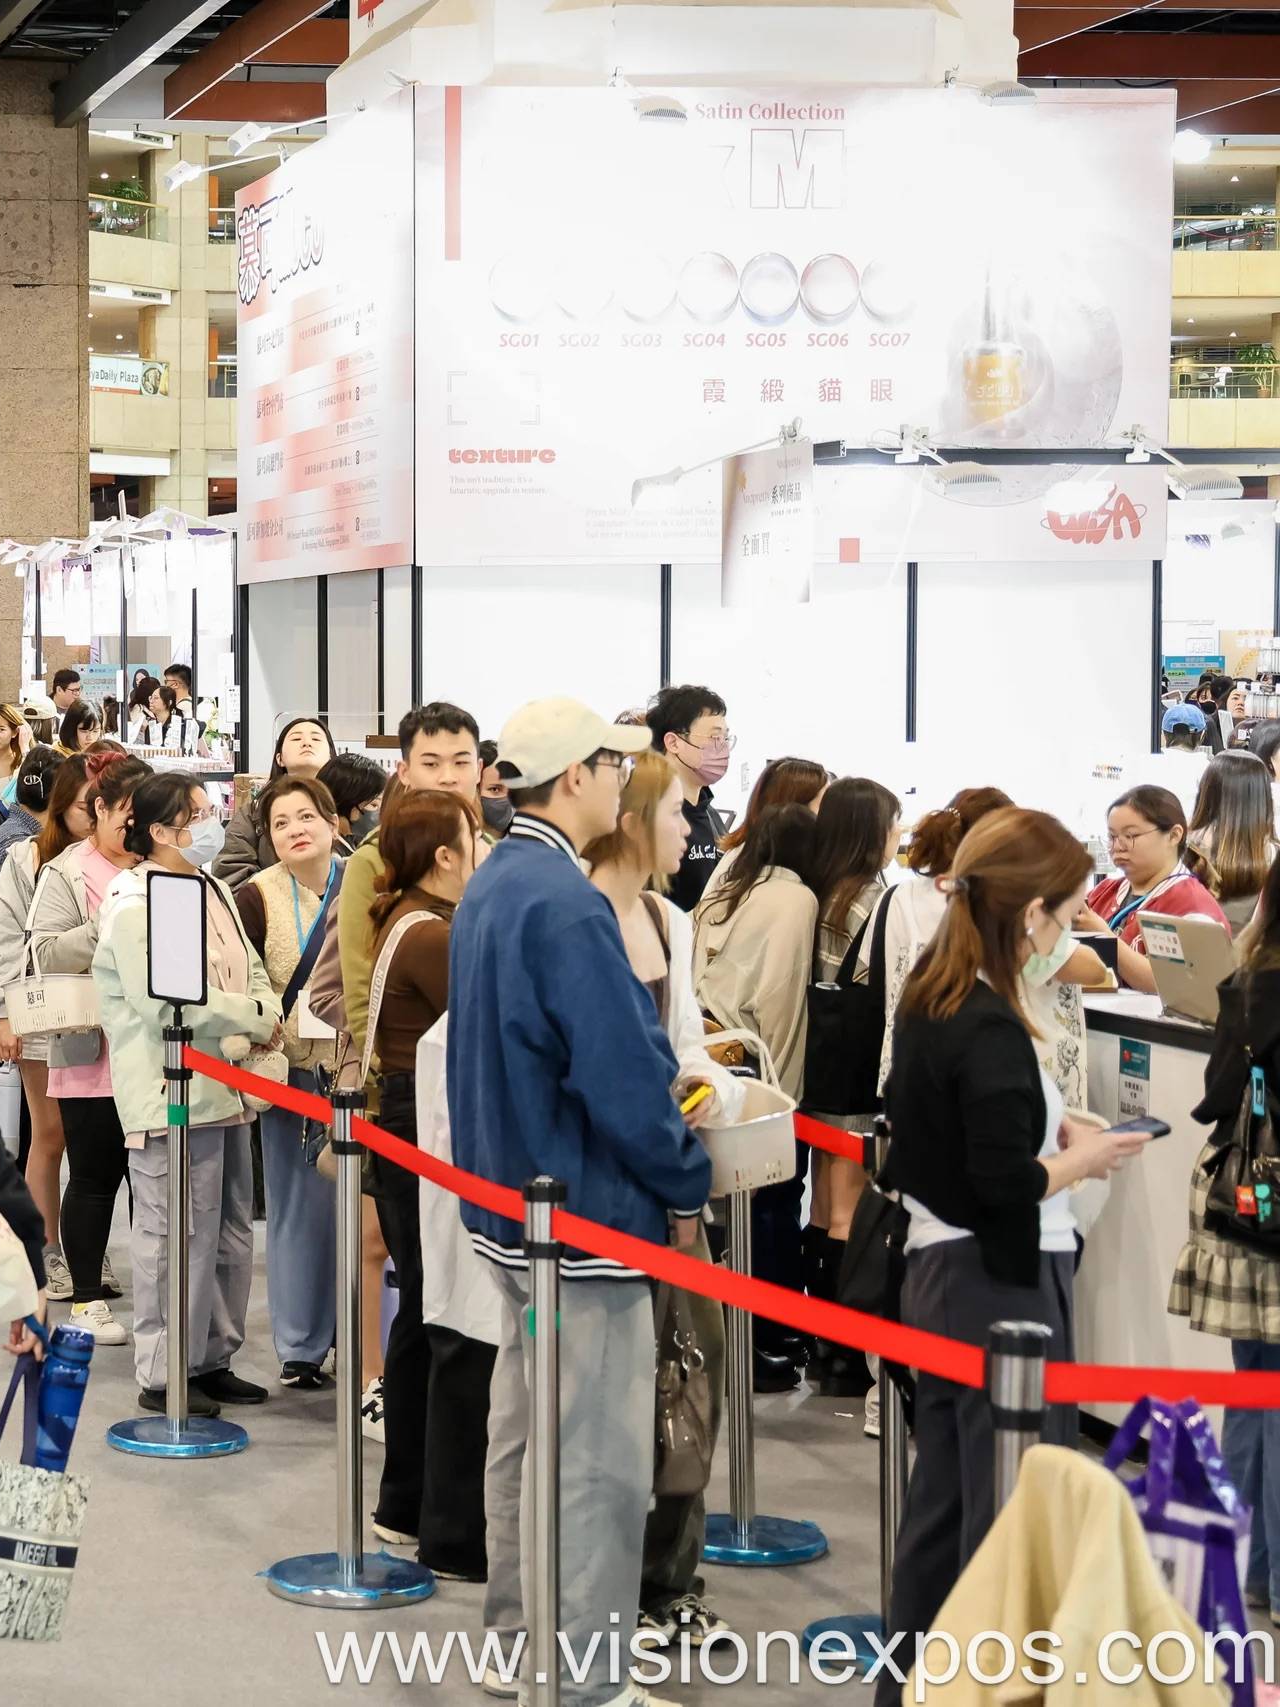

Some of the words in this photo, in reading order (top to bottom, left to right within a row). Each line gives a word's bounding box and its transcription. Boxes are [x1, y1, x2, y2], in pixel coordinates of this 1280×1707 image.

[695, 102, 743, 120] Satin
[749, 101, 845, 120] Collection
[499, 332, 541, 349] SG01
[621, 332, 663, 349] SG03
[683, 332, 726, 349] SG04
[745, 332, 788, 349] SG05
[807, 332, 850, 349] SG06
[868, 332, 911, 348] SG07
[119, 370, 139, 383] Plaza
[448, 447, 558, 465] texture
